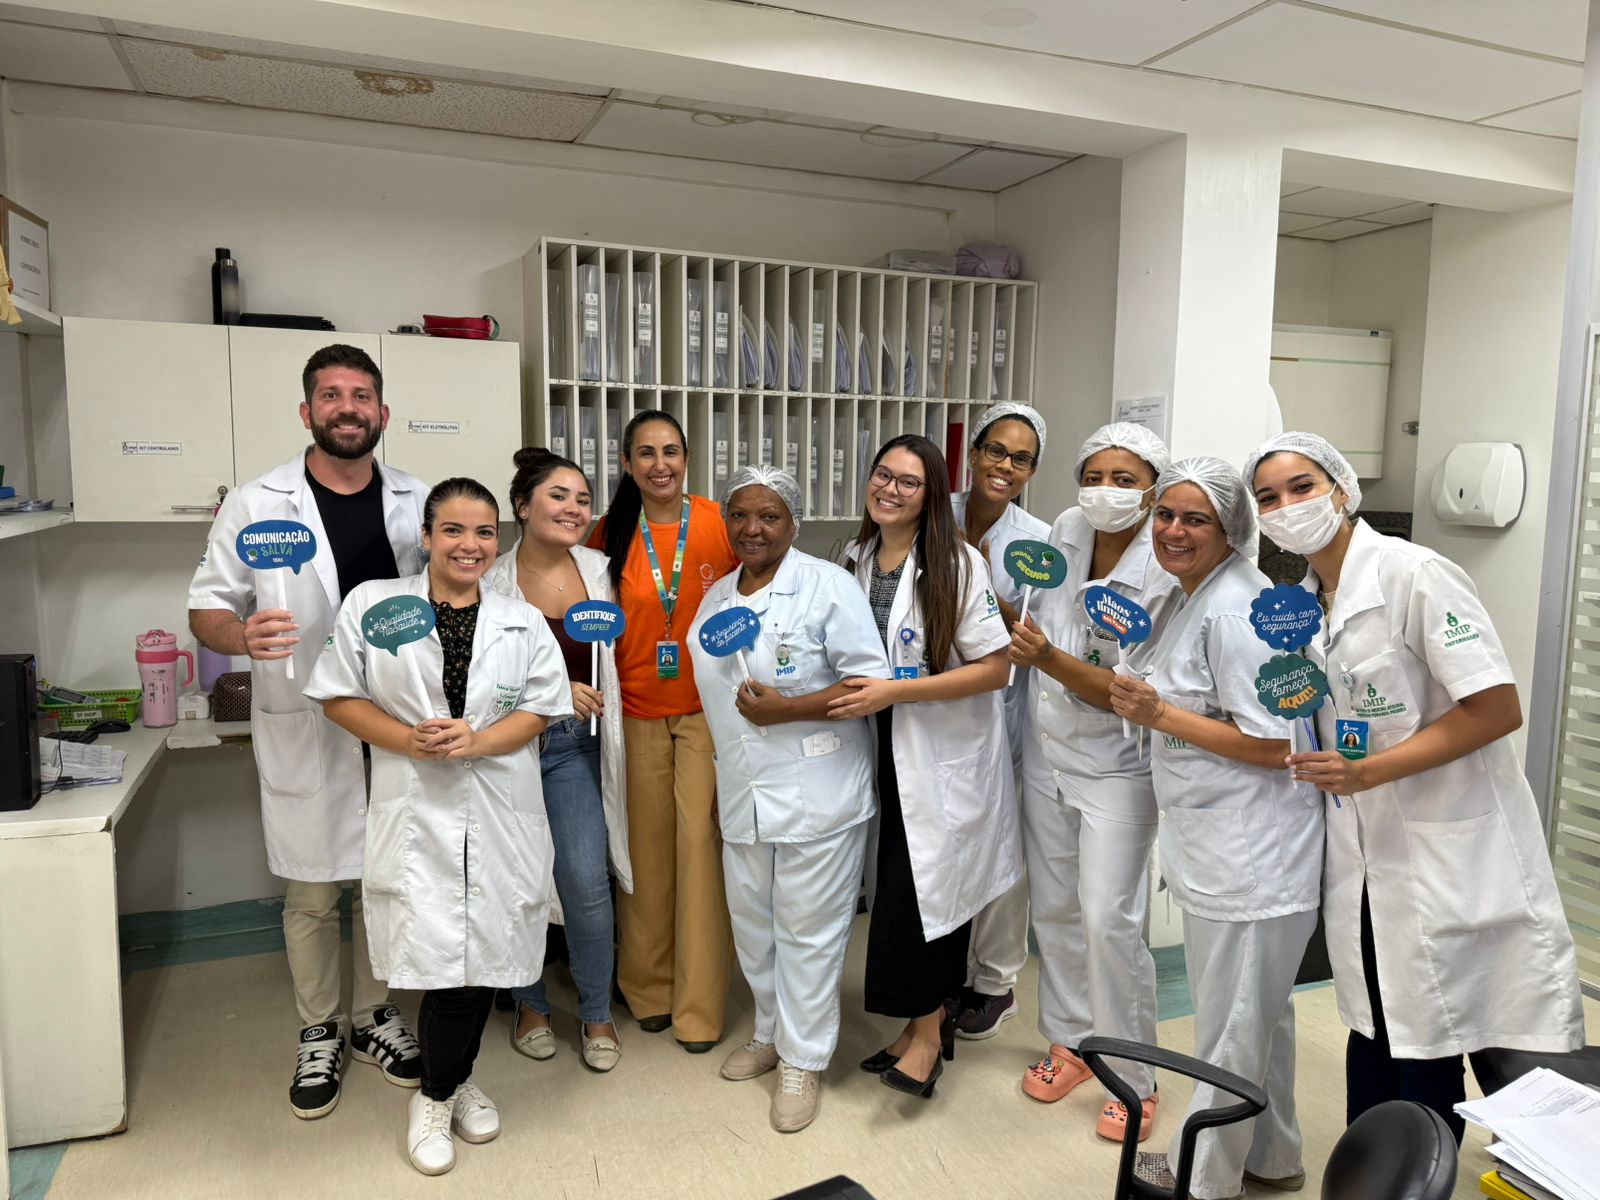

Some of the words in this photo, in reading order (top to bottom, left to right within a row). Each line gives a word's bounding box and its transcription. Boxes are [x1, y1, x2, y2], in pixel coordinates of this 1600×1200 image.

[243, 530, 310, 545] COMUNICAÇÃO
[261, 544, 293, 557] SALVA
[1016, 559, 1050, 581] SEGURO
[572, 610, 617, 622] IDENTIFIQUE
[1096, 600, 1135, 629] limpas
[1256, 612, 1270, 623] Eu
[1271, 612, 1296, 622] cuido
[1298, 608, 1317, 619] com
[581, 623, 611, 631] SEMPRE!
[1262, 616, 1314, 635] segurança!
[1444, 624, 1471, 639] IMIP
[775, 665, 796, 677] IMIP
[1260, 664, 1315, 693] Segurança
[1271, 677, 1311, 698] começa
[1362, 697, 1386, 708] IMIP
